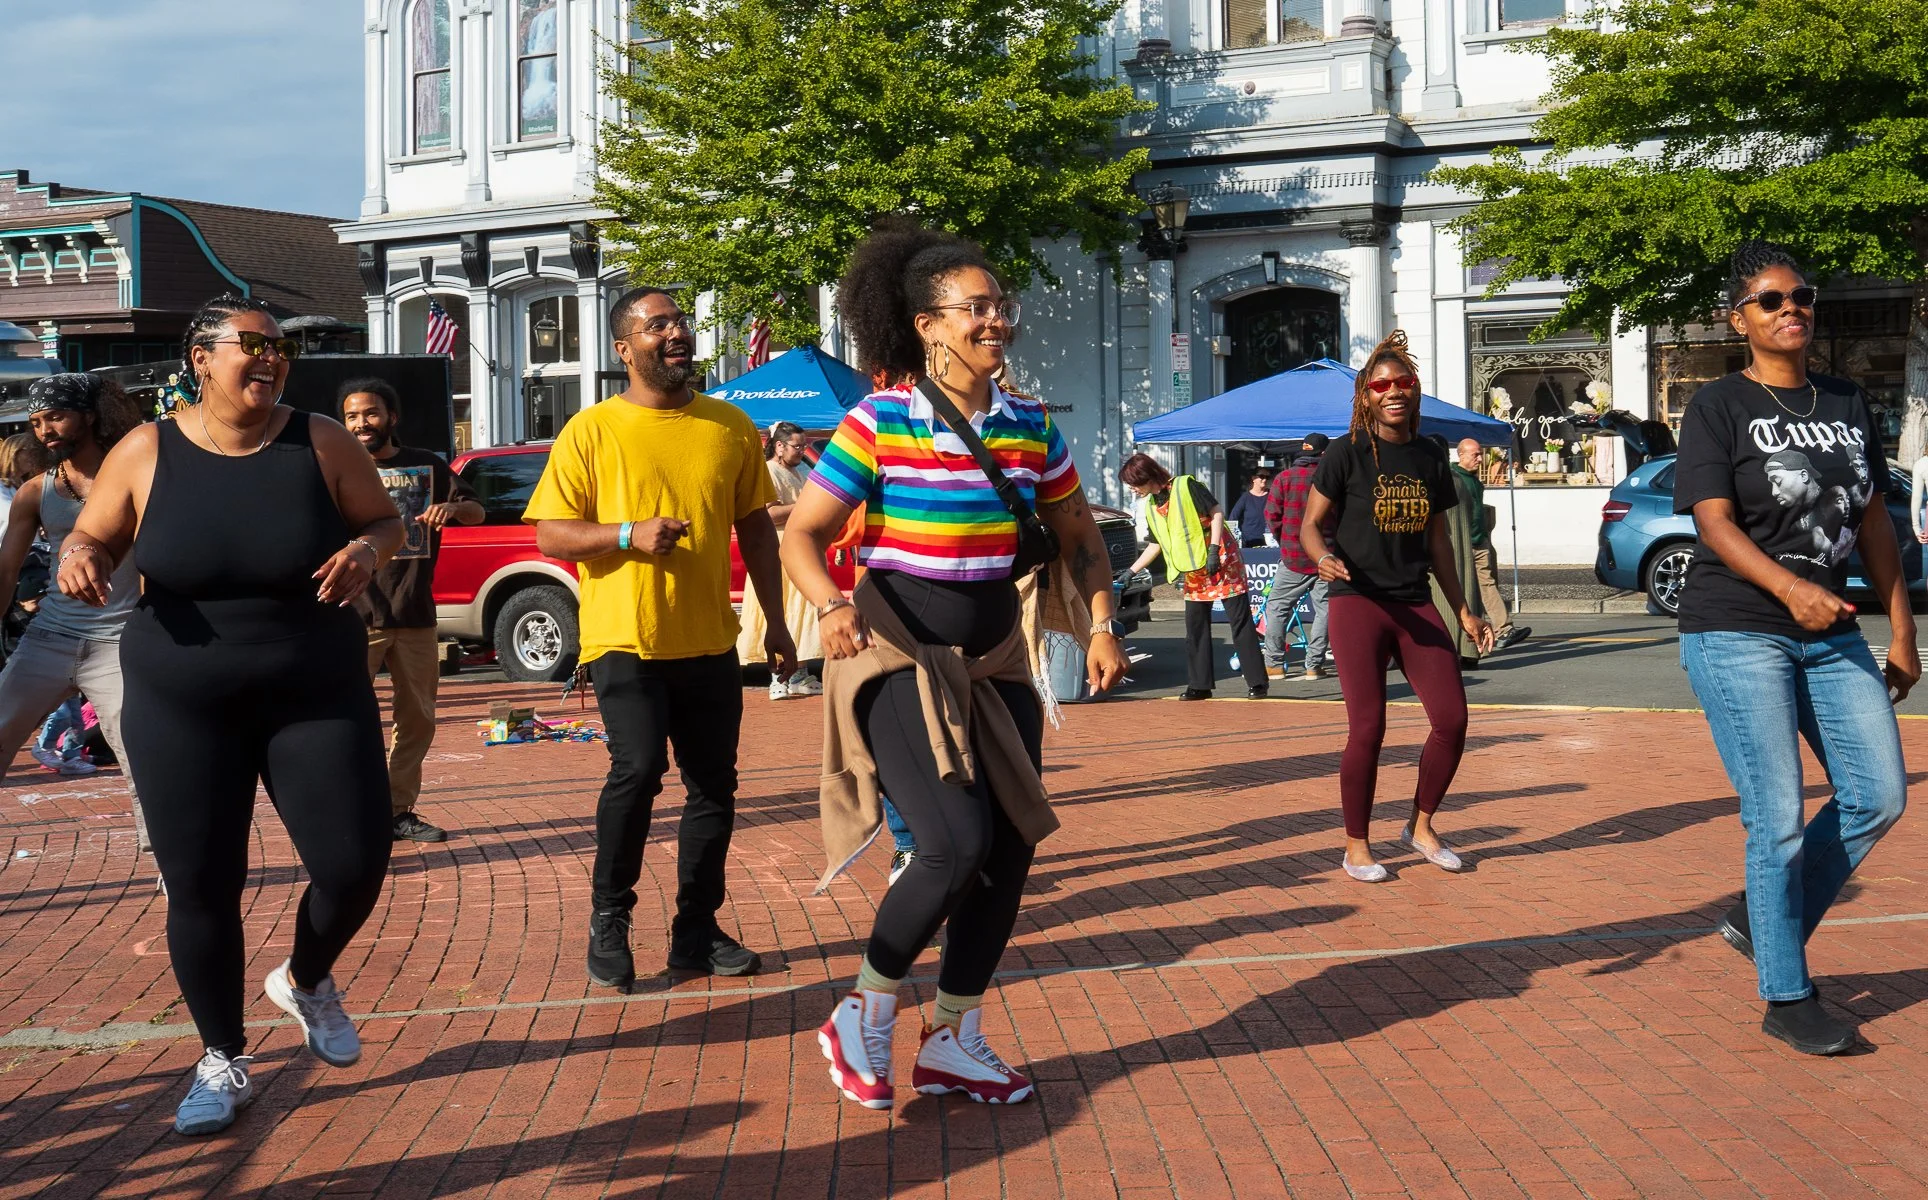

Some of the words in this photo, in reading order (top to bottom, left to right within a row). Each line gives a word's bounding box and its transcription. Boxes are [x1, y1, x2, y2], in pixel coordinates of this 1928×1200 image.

[726, 388, 820, 400] Providence
[1046, 403, 1073, 412] Street
[1538, 415, 1567, 439] goo
[382, 475, 419, 488] QUIAT
[1373, 474, 1428, 498] Smart
[1375, 499, 1430, 517] GIFTED
[1374, 516, 1428, 534] Powerful
[1245, 564, 1279, 578] NOR
